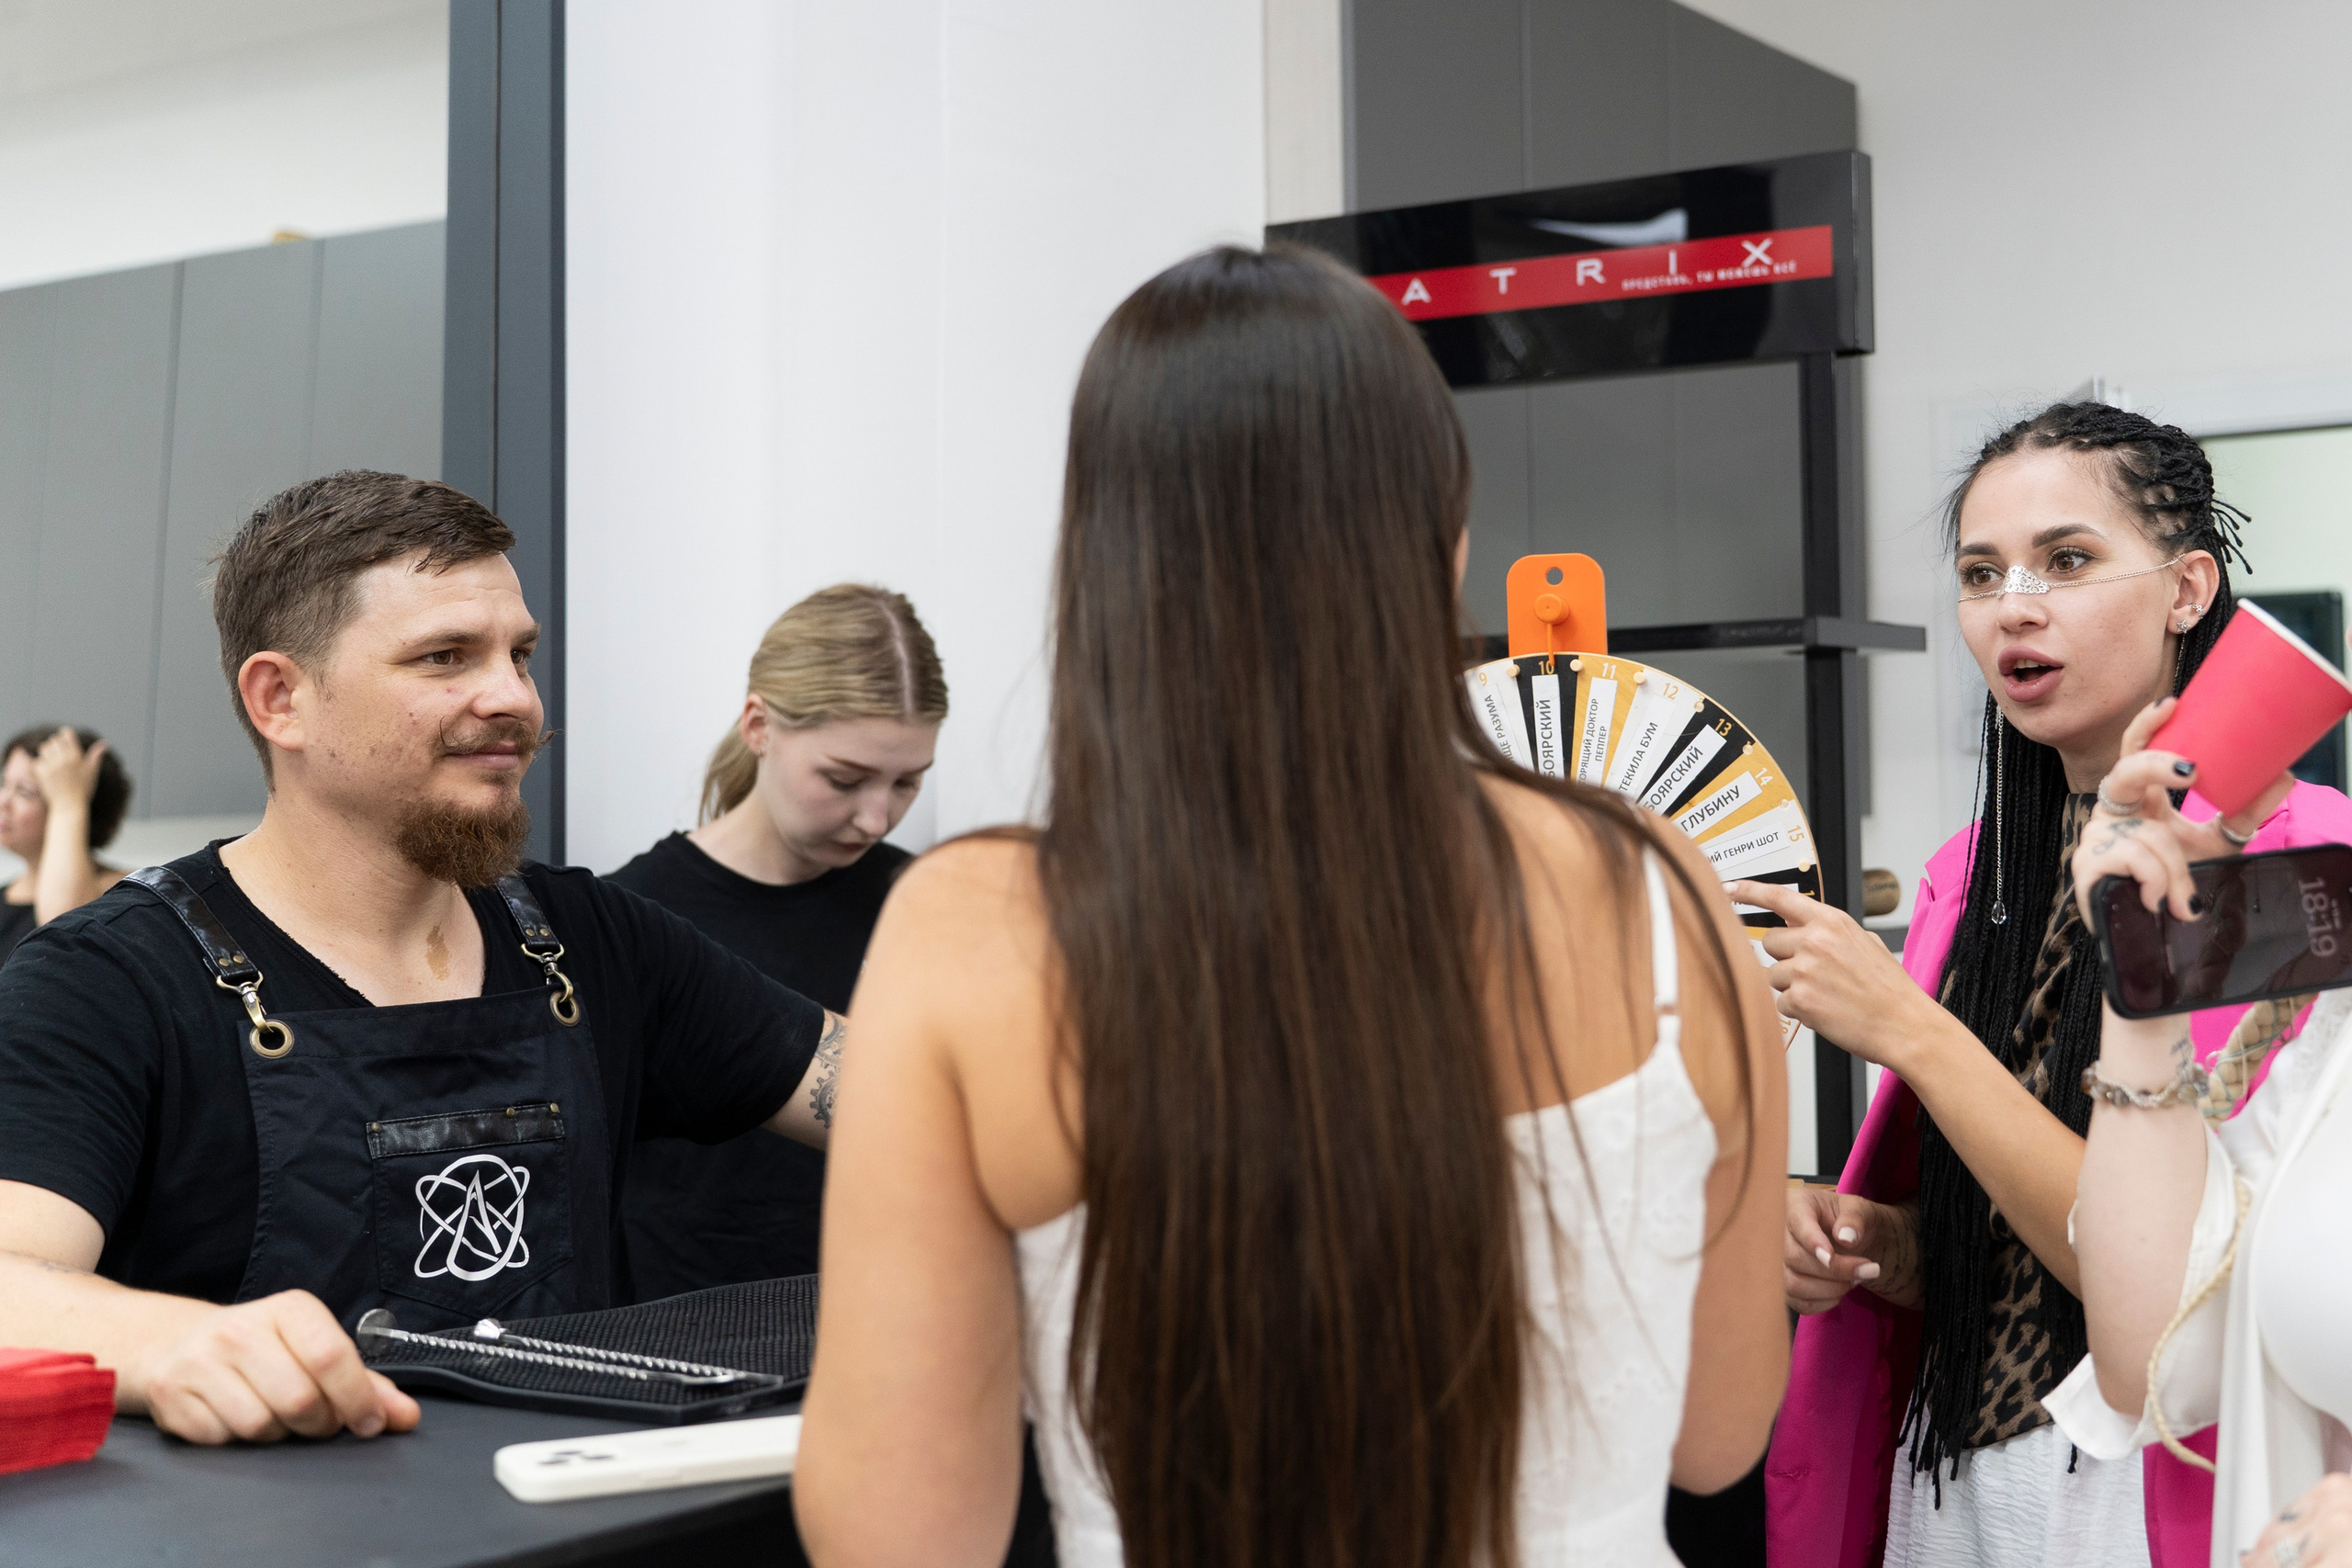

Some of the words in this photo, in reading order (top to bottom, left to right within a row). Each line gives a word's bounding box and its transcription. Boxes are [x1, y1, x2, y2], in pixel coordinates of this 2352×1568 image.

[1401, 237, 1774, 306] ATRIX
[1478, 671, 1487, 686] 9
[1539, 660, 1555, 675] 10
[1601, 662, 1617, 679] 11
[1662, 682, 1679, 700] 12
[1484, 694, 1506, 739] РАЗУМА
[1715, 717, 1733, 737] 13
[1578, 739, 1593, 781] ОРЯЩИЙ
[1586, 698, 1599, 738] ДОКТОР
[1595, 726, 1607, 761] ПЕППЕР
[1619, 750, 1645, 791] ТЕКИЛА
[1640, 721, 1658, 749] БУМ
[1755, 768, 1773, 786] 14
[1680, 785, 1740, 832] ГЛУБИНУ
[1724, 840, 1755, 859] ГЕНРИ
[1756, 831, 1781, 847] ШОТ
[1788, 825, 1804, 842] 15
[2298, 877, 2338, 956] 18:19
